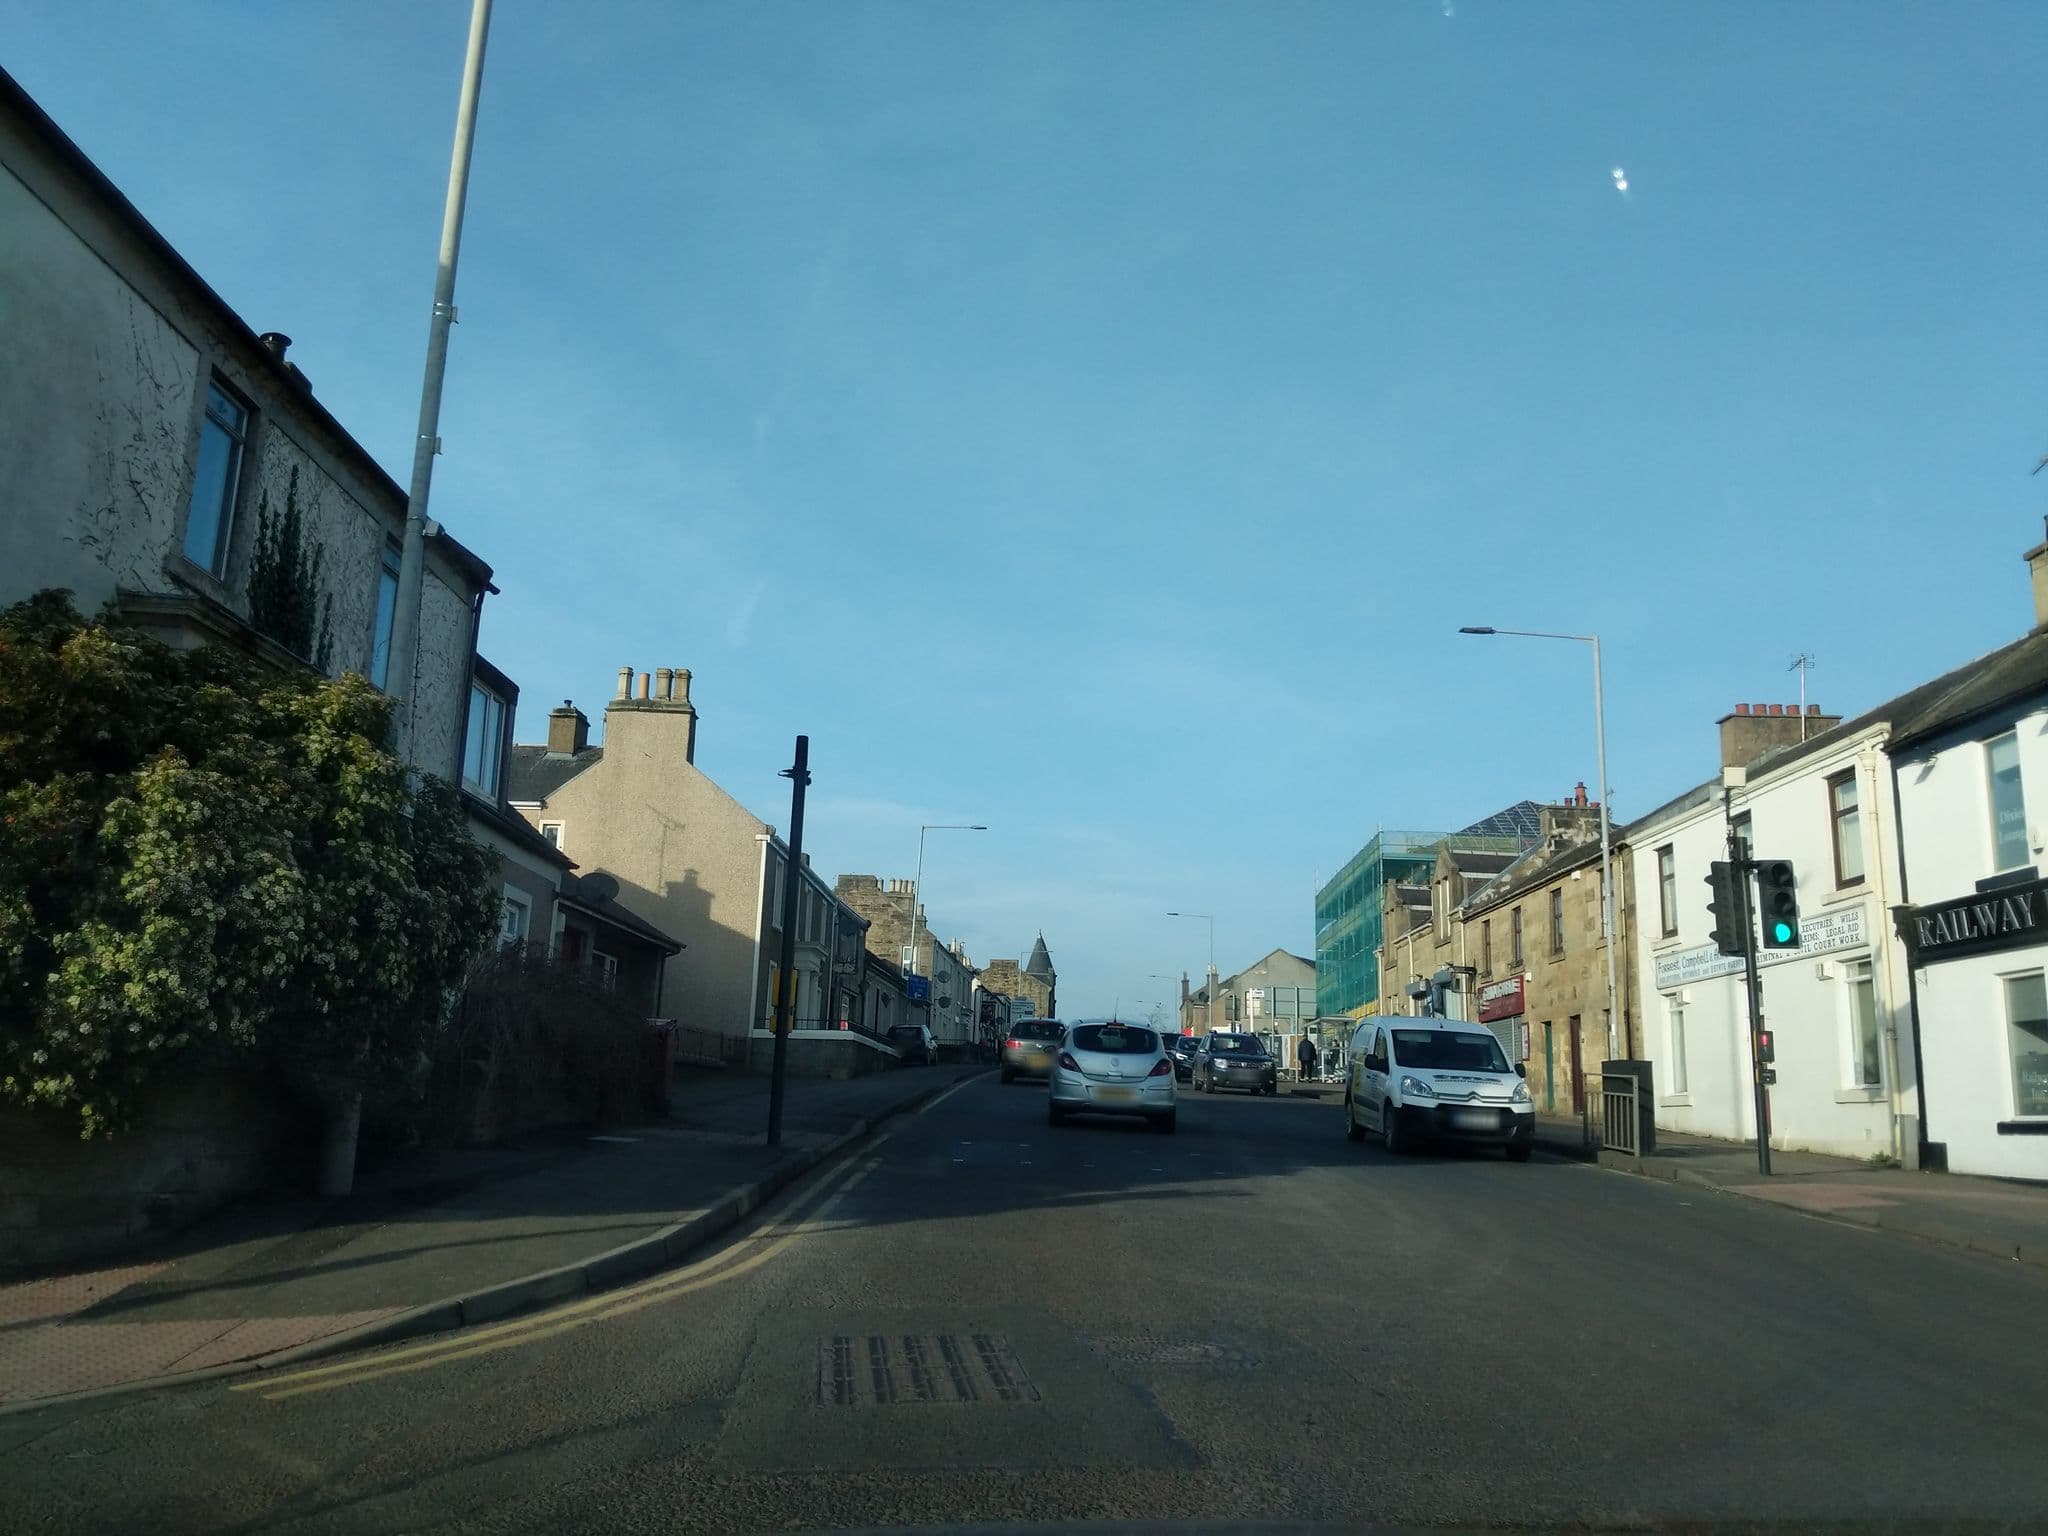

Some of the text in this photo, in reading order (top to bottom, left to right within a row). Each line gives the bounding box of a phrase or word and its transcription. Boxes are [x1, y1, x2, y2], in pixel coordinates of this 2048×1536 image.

[1840, 912, 1859, 923] WILLS
[1914, 892, 2036, 948] RAILWAY
[1826, 926, 1846, 938] LEGAL
[1848, 923, 1859, 933] AID
[1813, 938, 1836, 950] COURT
[1839, 933, 1861, 945] WORK
